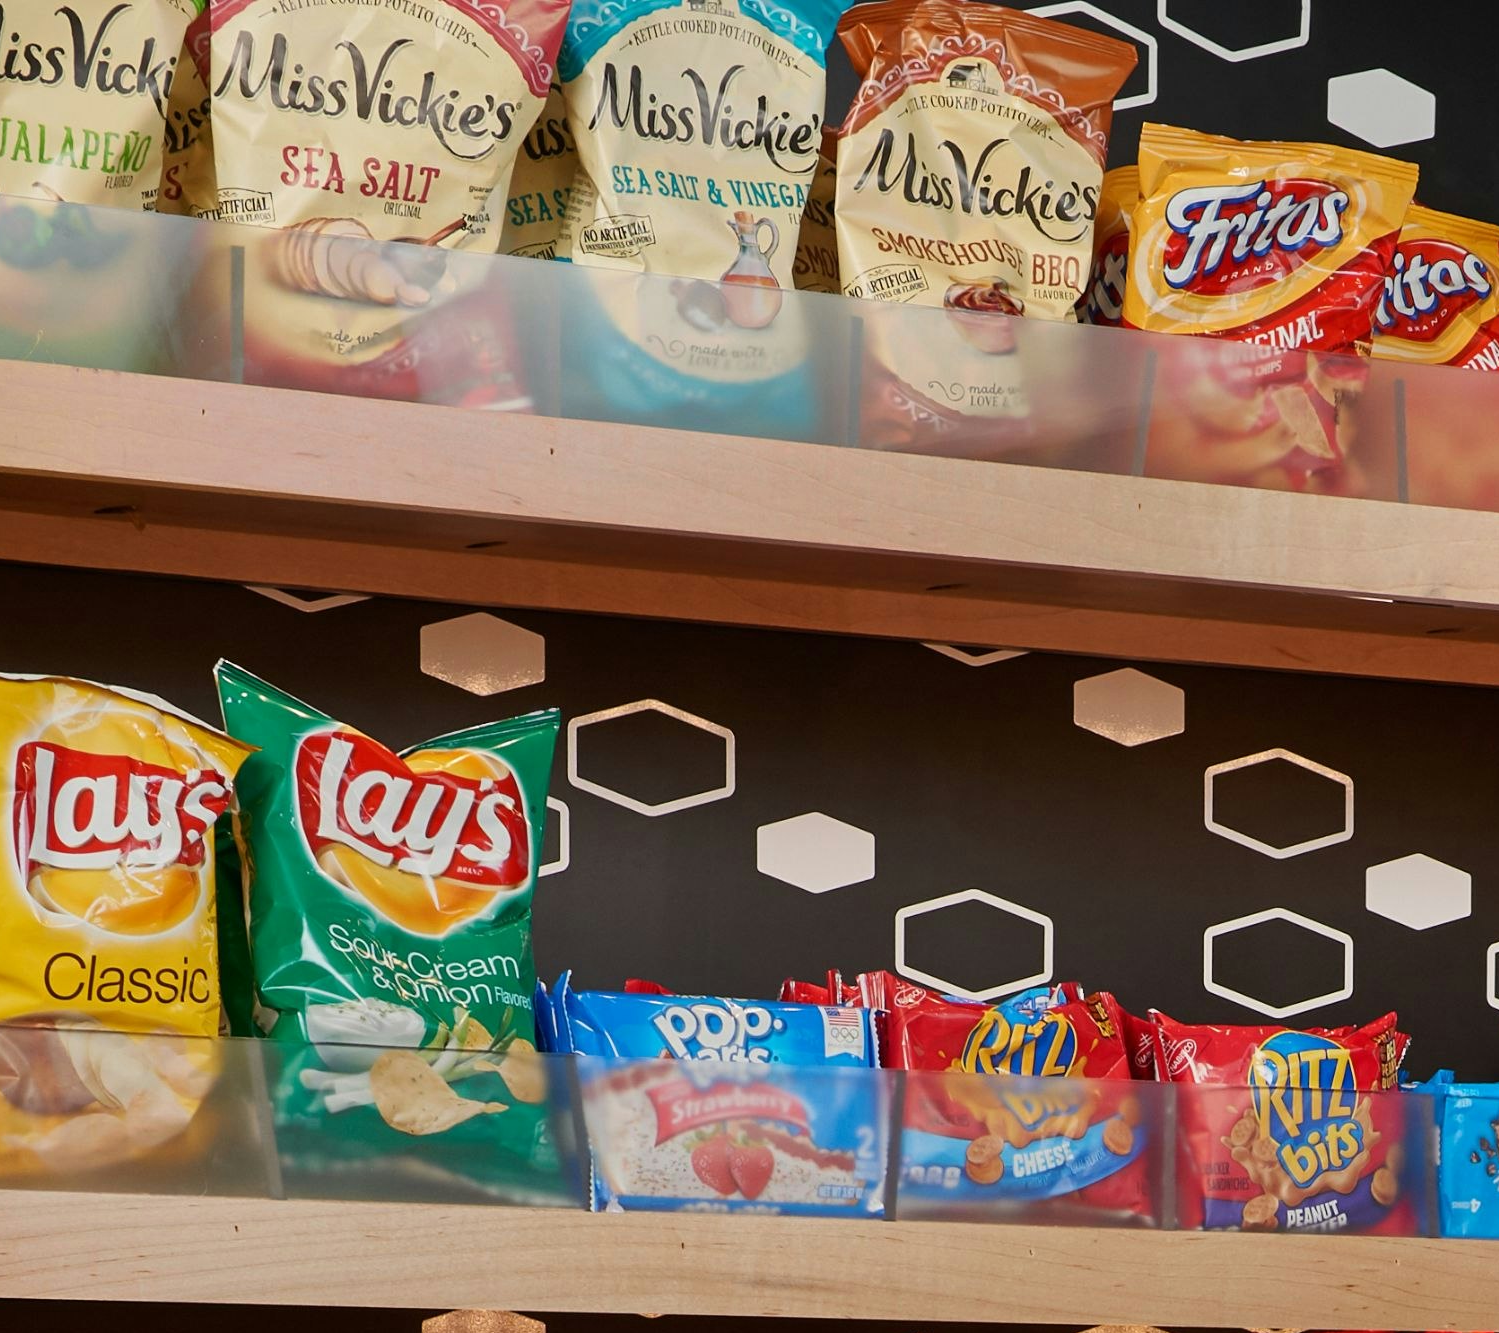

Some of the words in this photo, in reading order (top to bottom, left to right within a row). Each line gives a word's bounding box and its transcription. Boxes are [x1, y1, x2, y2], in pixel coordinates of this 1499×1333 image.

[633, 22, 672, 46] KETTLE
[674, 19, 716, 34] COOKED
[720, 23, 760, 48] POTATO
[762, 39, 794, 67] CHIPS
[215, 30, 345, 114] Miss
[335, 38, 516, 159] Vickie's
[589, 63, 694, 143] Miss
[931, 95, 977, 111] COOKED
[982, 100, 1026, 122] POTATO
[281, 145, 344, 193] SEA
[361, 158, 440, 203] SALT
[612, 166, 652, 196] SEA
[659, 171, 698, 201] SALT
[708, 180, 723, 206] &
[855, 128, 953, 203] Miss
[937, 138, 1099, 241] Vickie's
[384, 202, 422, 219] ORIGINAL
[1163, 180, 1349, 289] Fritos
[872, 227, 1024, 277] SMOKEHOUSE
[1032, 254, 1083, 295] BBQ
[1220, 262, 1275, 283] BRAND
[1033, 289, 1074, 301] FLAVORED
[1407, 308, 1448, 333] BRAND
[29, 747, 230, 871] Lay's
[318, 739, 516, 876] Lay's
[457, 866, 484, 877] BRAND
[44, 953, 209, 1004] Classic
[329, 924, 399, 971] Sour
[408, 952, 520, 983] Cream
[372, 966, 396, 989] &
[394, 973, 496, 1008] Onion
[495, 987, 531, 1010] Flavored
[1252, 1048, 1351, 1140] RITZ
[1012, 1142, 1073, 1178] CHEESE
[1281, 1122, 1359, 1184] bits
[1286, 1199, 1339, 1228] PEANUT
